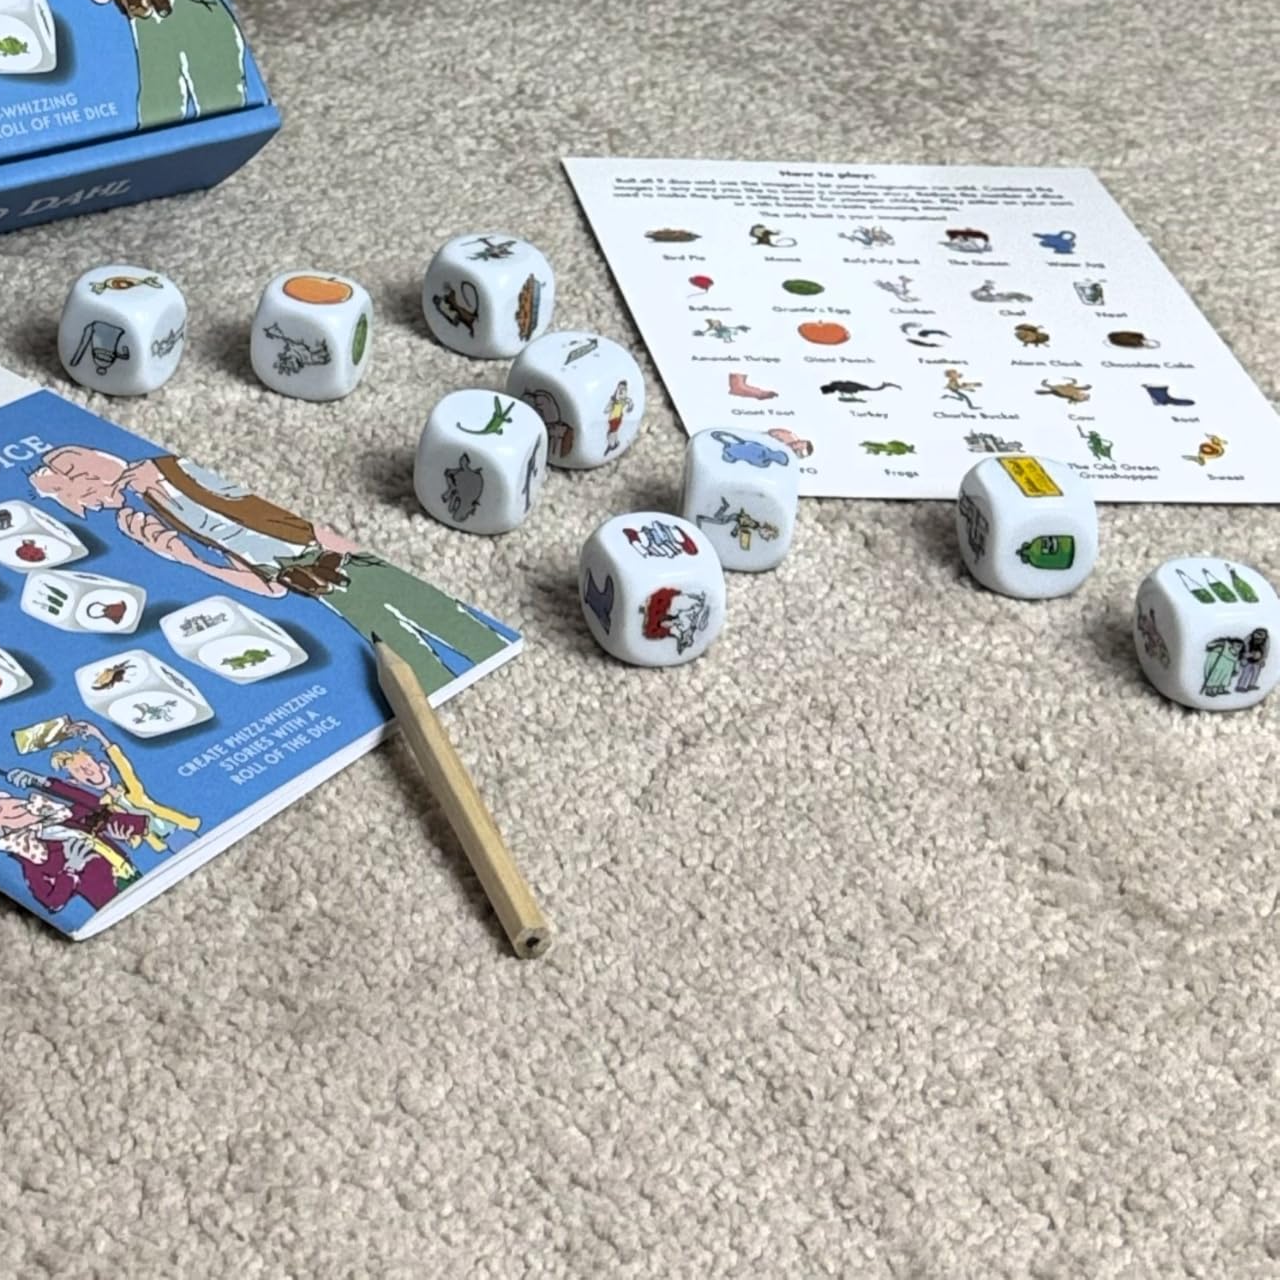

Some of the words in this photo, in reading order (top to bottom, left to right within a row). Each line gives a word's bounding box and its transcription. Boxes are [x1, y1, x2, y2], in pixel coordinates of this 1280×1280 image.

[30, 114, 52, 132] OF
[53, 108, 83, 127] THE
[83, 101, 120, 121] DICE
[19, 178, 132, 216] DAHL
[219, 735, 275, 772] STORIES
[269, 716, 309, 741] WITH
[304, 709, 322, 722] A
[228, 761, 268, 787] ROLL
[262, 748, 287, 766] OF
[280, 733, 313, 754] THE
[306, 714, 343, 740] DICE
[176, 743, 229, 778] CREATE
